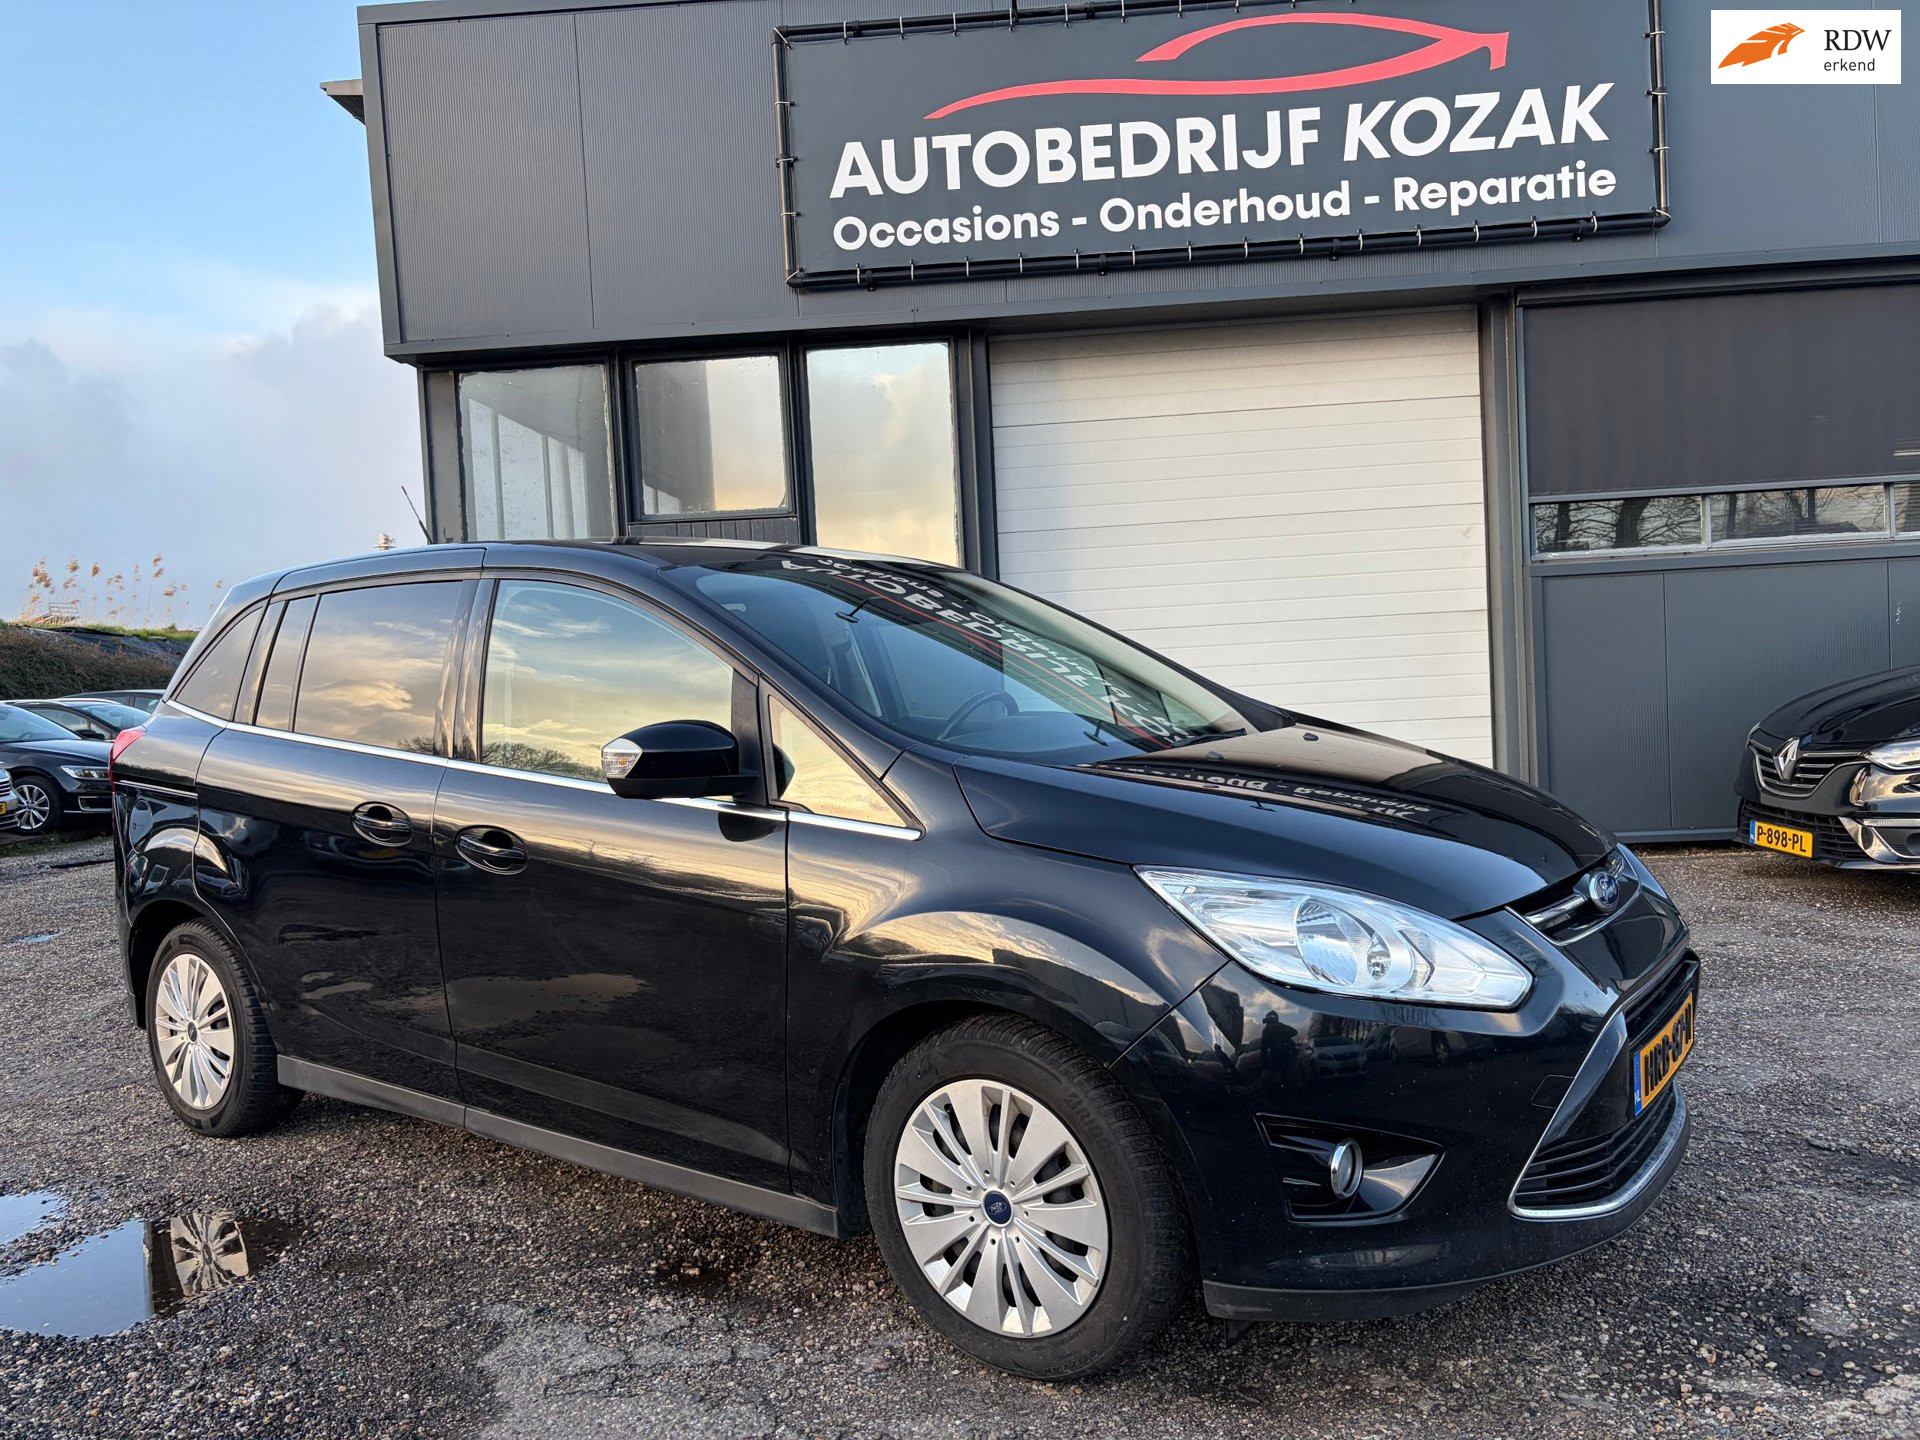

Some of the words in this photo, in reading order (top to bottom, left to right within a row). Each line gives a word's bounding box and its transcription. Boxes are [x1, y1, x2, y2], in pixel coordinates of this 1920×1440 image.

[829, 106, 1321, 199] AUTOBEDRIJF
[1343, 82, 1615, 162] KOZAK
[833, 205, 1060, 251] Occasions
[1099, 180, 1351, 233] Onderhoud
[1393, 160, 1617, 217] Reparatie
[1757, 825, 1807, 853] P-898-PL
